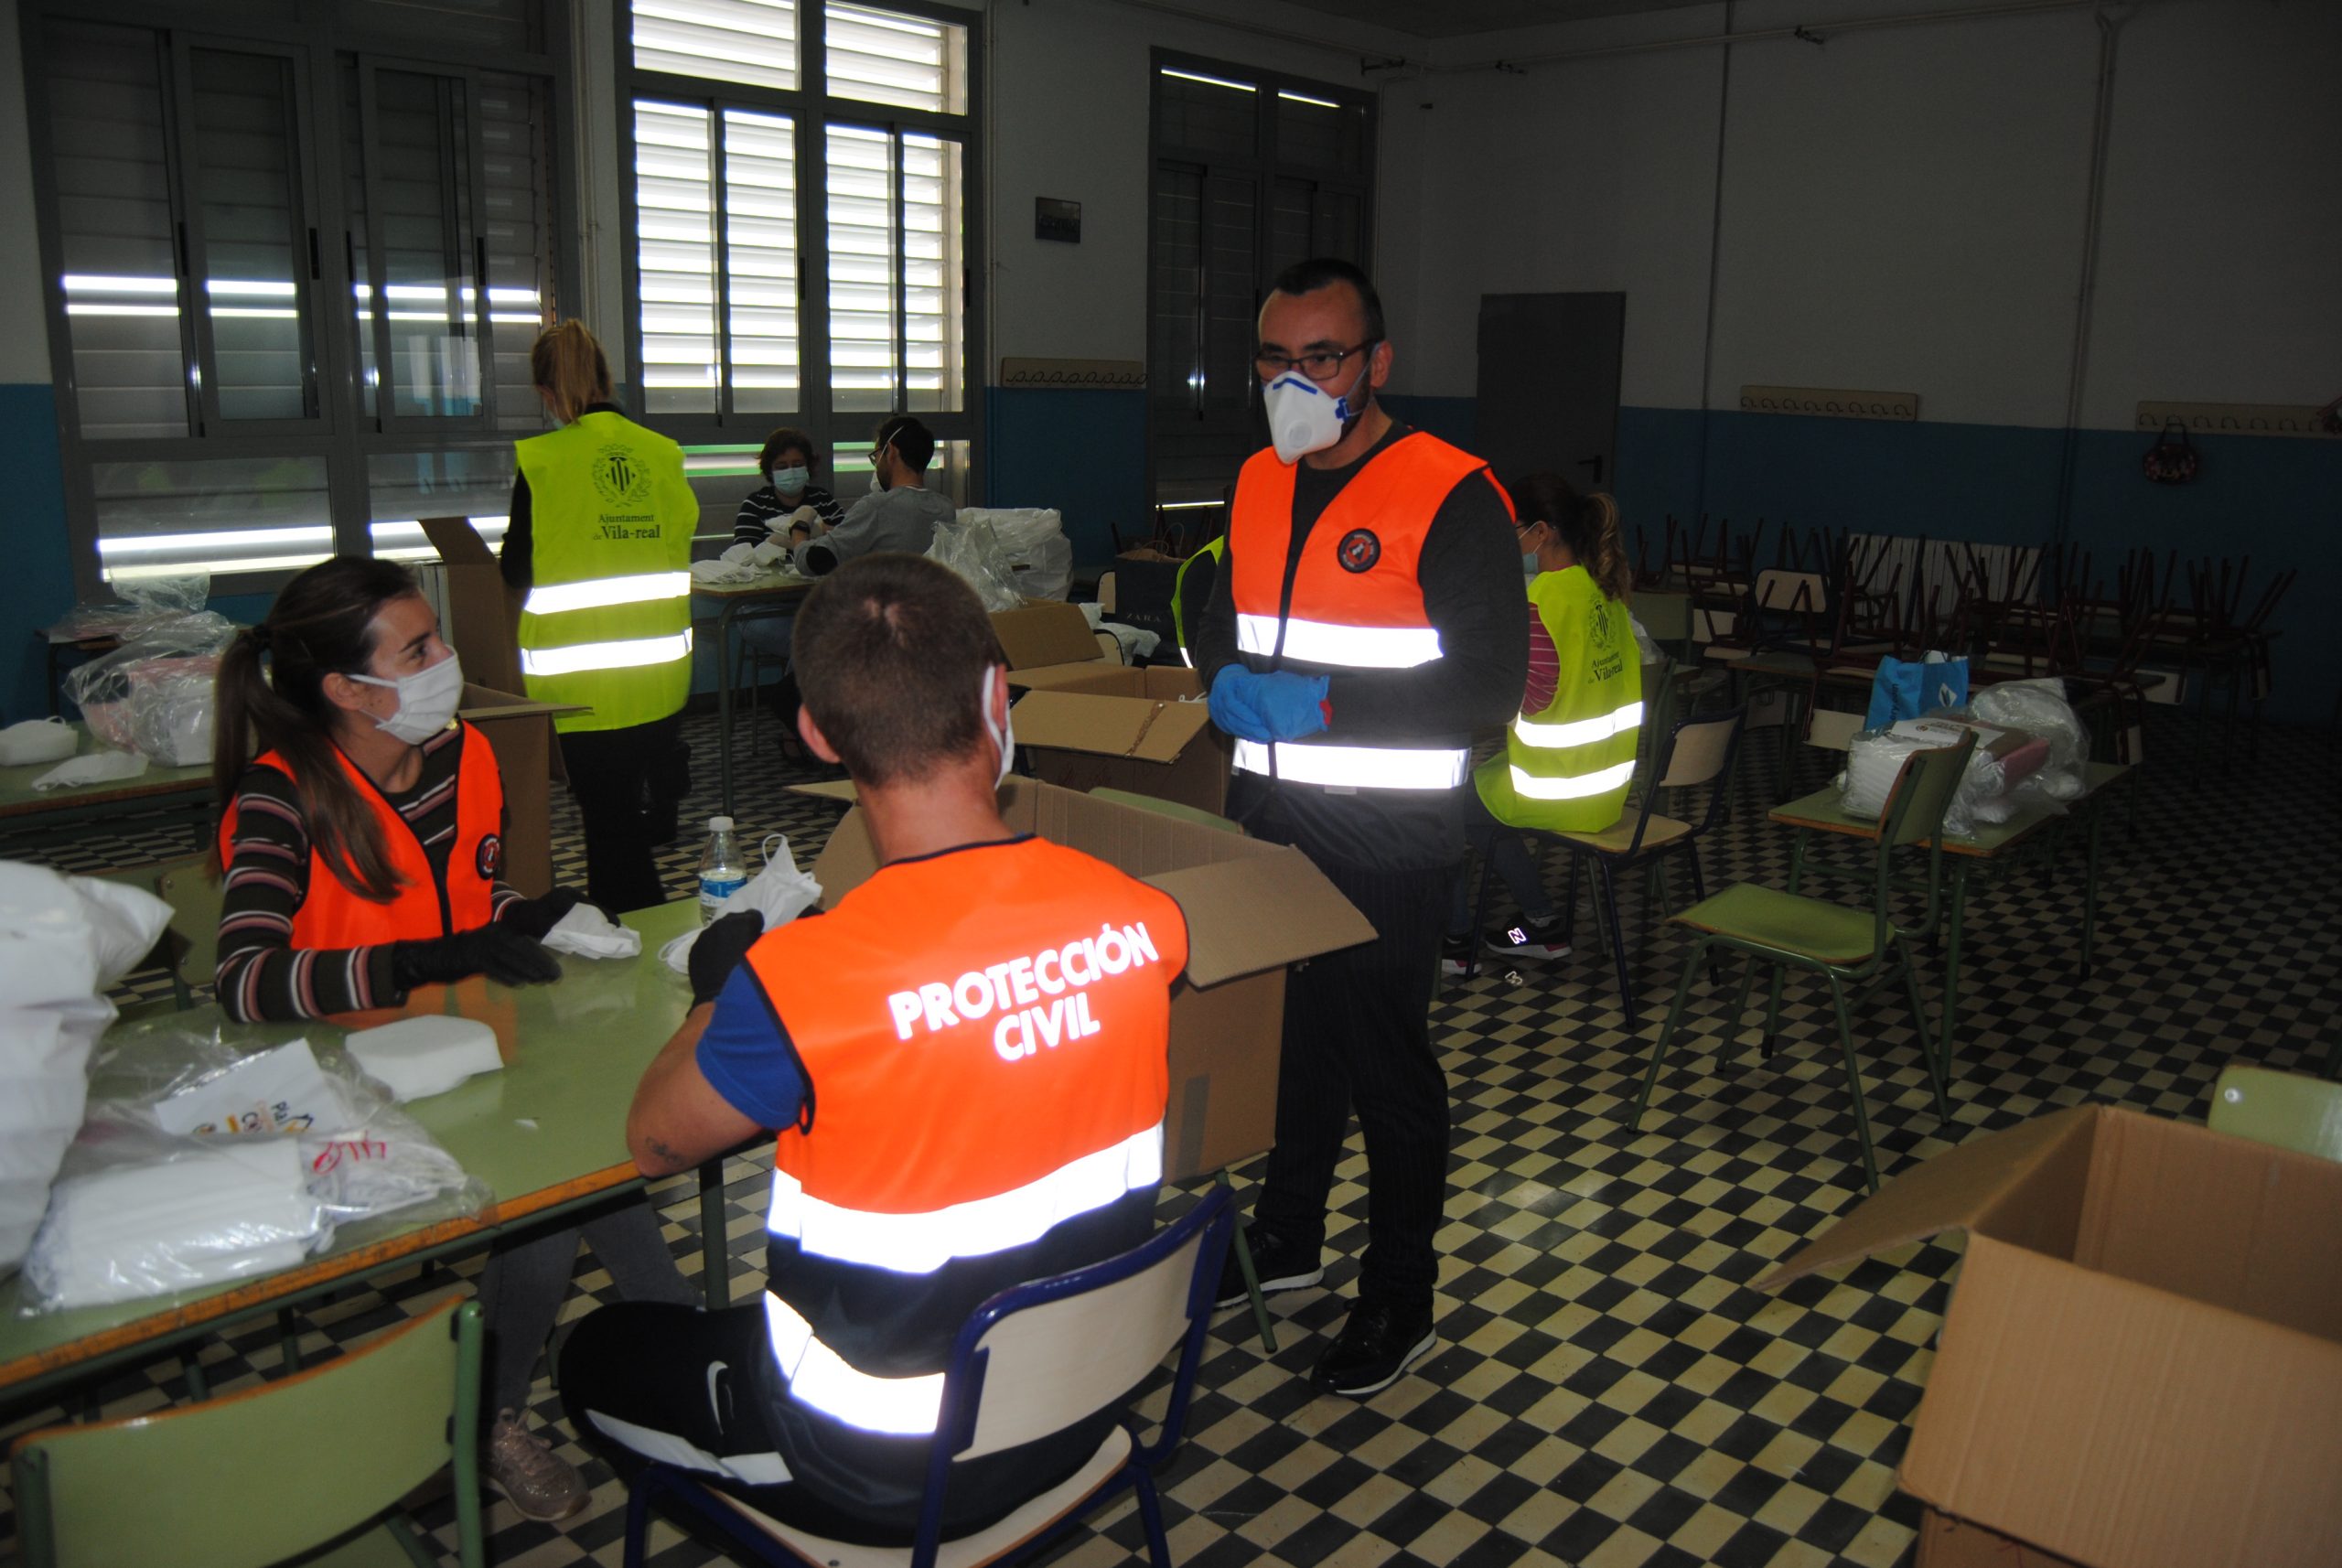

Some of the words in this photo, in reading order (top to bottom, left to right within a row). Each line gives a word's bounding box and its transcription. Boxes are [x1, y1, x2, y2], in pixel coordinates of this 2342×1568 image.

[599, 514, 656, 523] Ajuntament
[601, 525, 661, 540] Vila-real
[1126, 613, 1163, 622] ZARA
[887, 921, 1160, 1040] PROTECCIÓN
[994, 992, 1101, 1061] CIVIL
